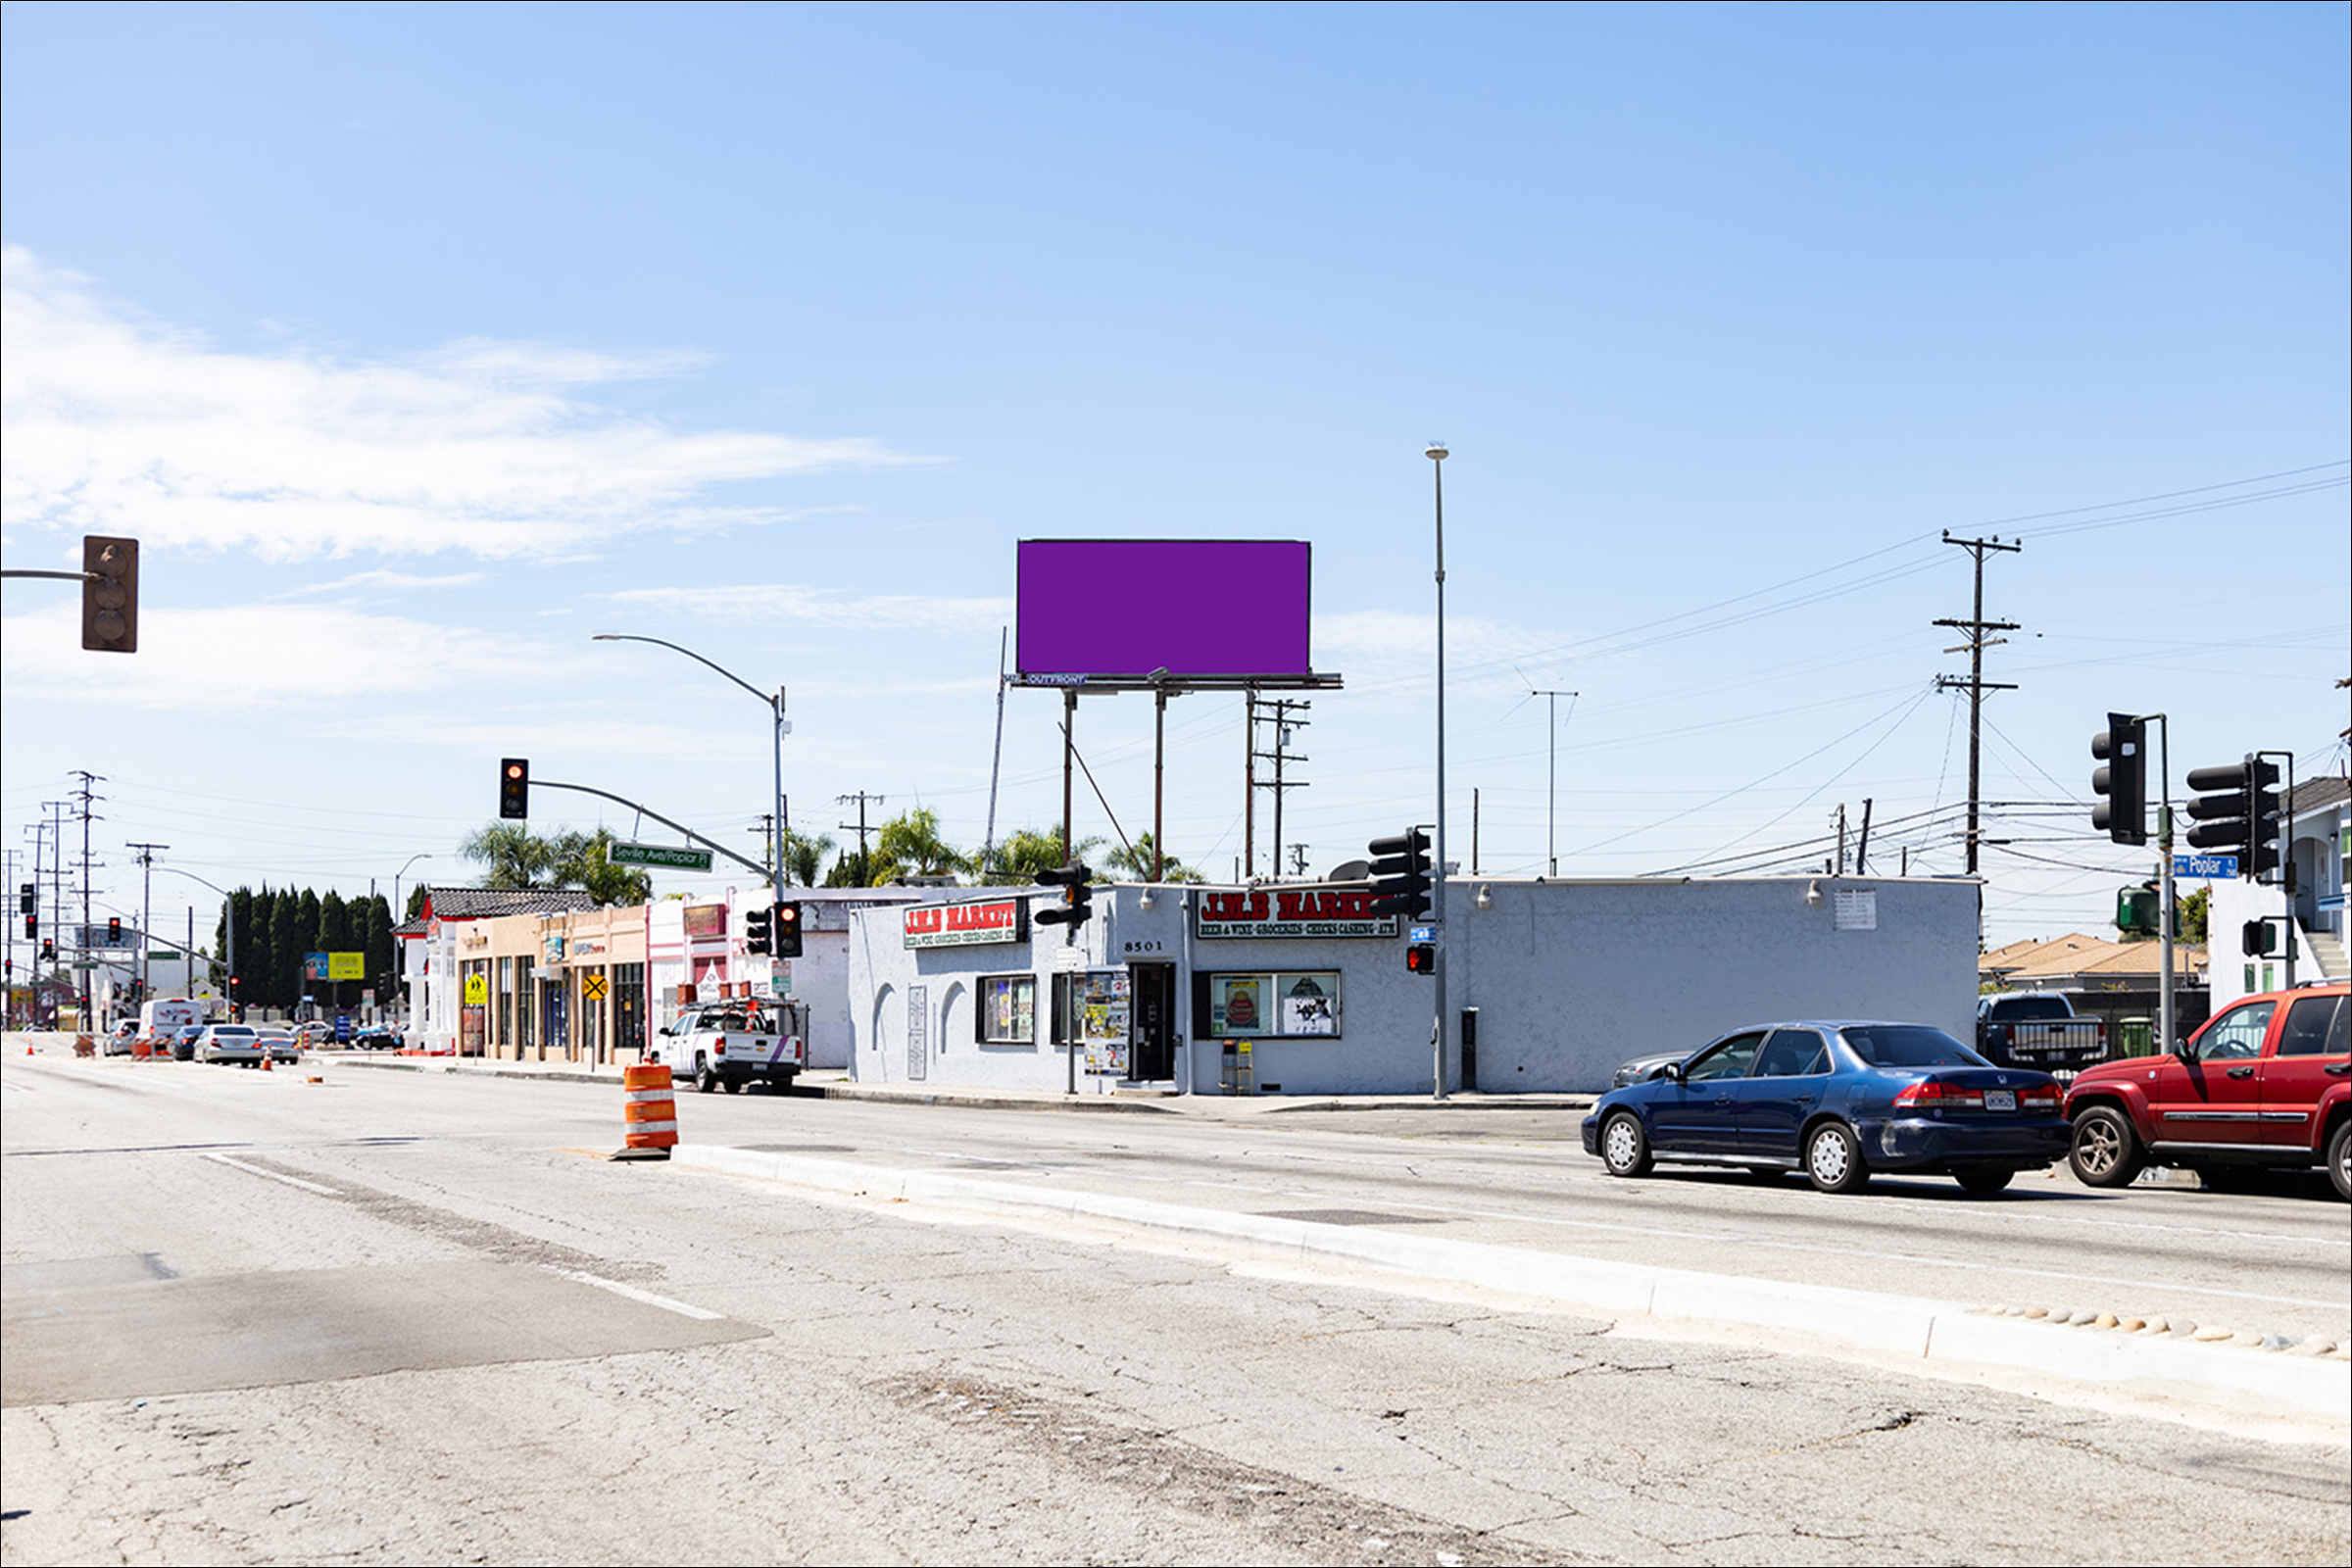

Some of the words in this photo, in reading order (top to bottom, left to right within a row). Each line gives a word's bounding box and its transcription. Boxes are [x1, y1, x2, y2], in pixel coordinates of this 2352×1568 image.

[1028, 673, 1085, 685] OUTFRONT
[615, 847, 645, 859] Seville
[2189, 856, 2221, 877] Poplar
[947, 902, 1016, 931] MARKET
[1124, 941, 1162, 953] 8501
